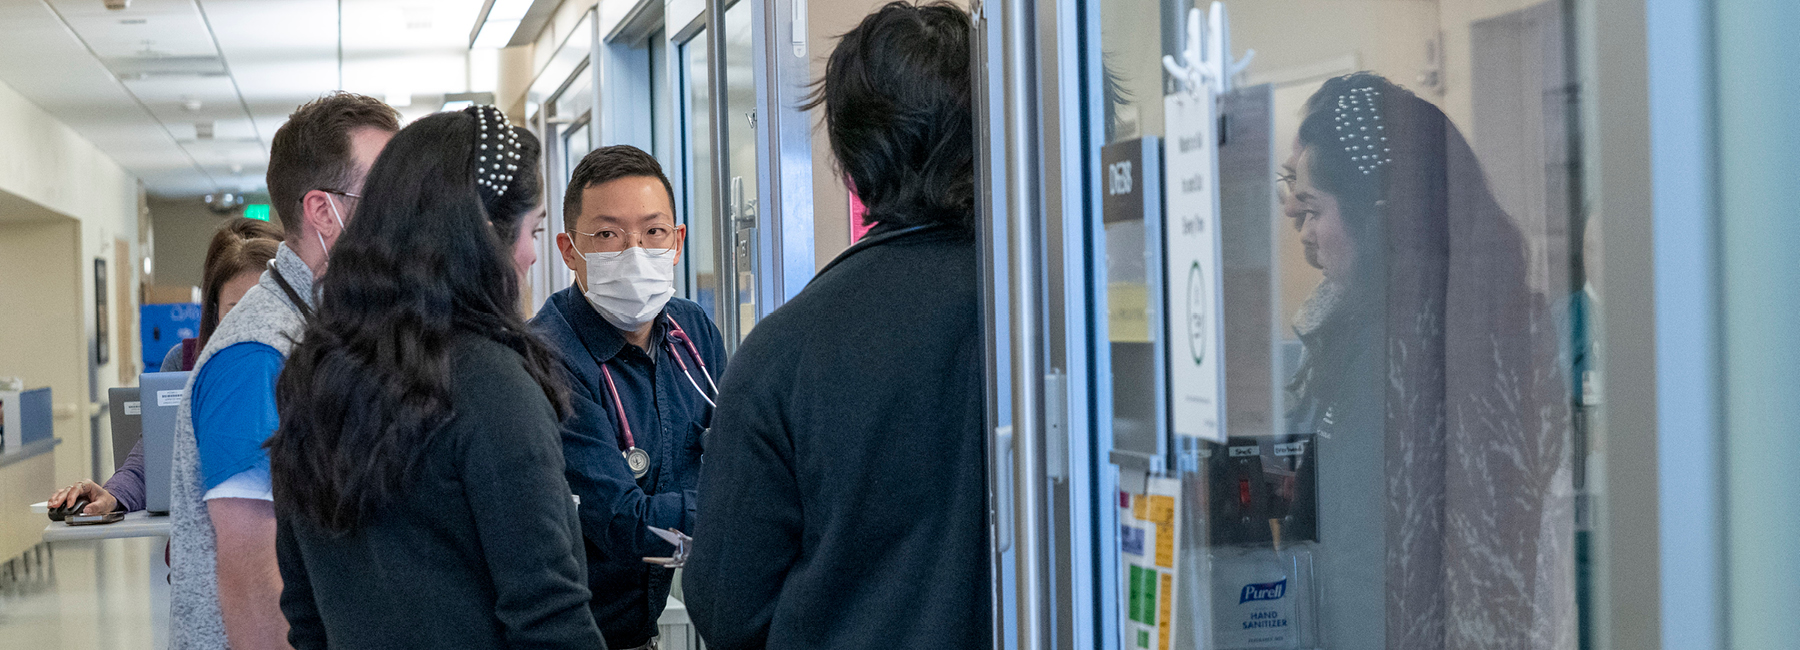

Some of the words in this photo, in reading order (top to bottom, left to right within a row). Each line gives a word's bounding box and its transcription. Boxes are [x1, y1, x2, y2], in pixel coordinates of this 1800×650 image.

[1245, 584, 1283, 600] Purell
[1250, 611, 1278, 620] HAND
[1242, 619, 1288, 630] SANITIZER
